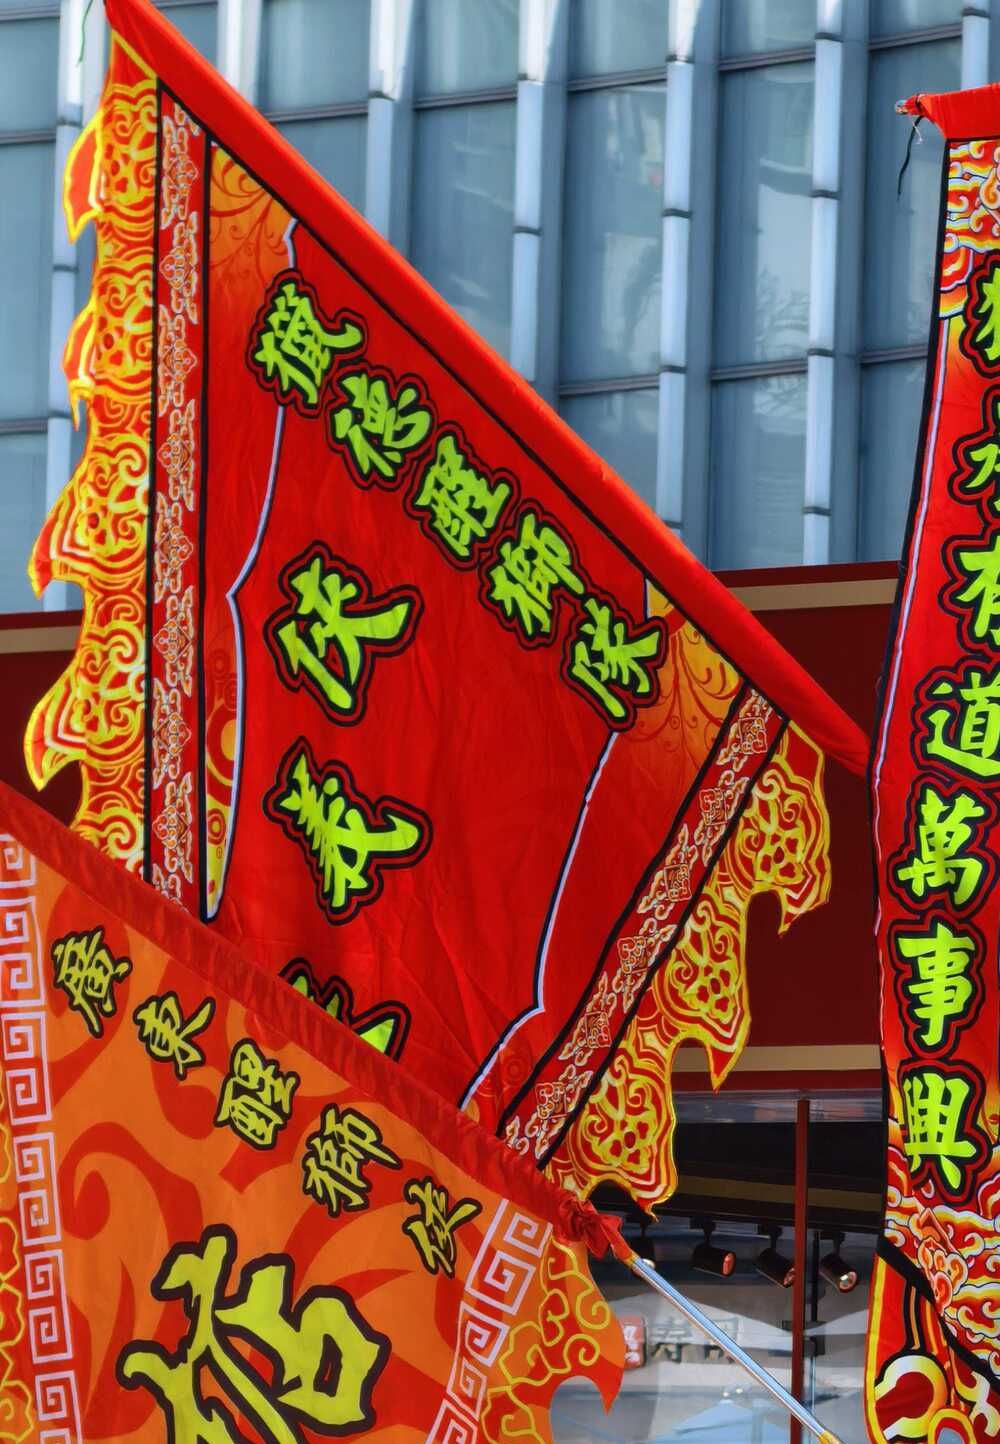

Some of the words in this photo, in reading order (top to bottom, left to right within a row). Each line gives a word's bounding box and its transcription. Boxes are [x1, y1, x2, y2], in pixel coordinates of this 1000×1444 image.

[252, 283, 664, 720] 獵德醒獅隊
[53, 928, 480, 1276] 廣東醒獅俠
